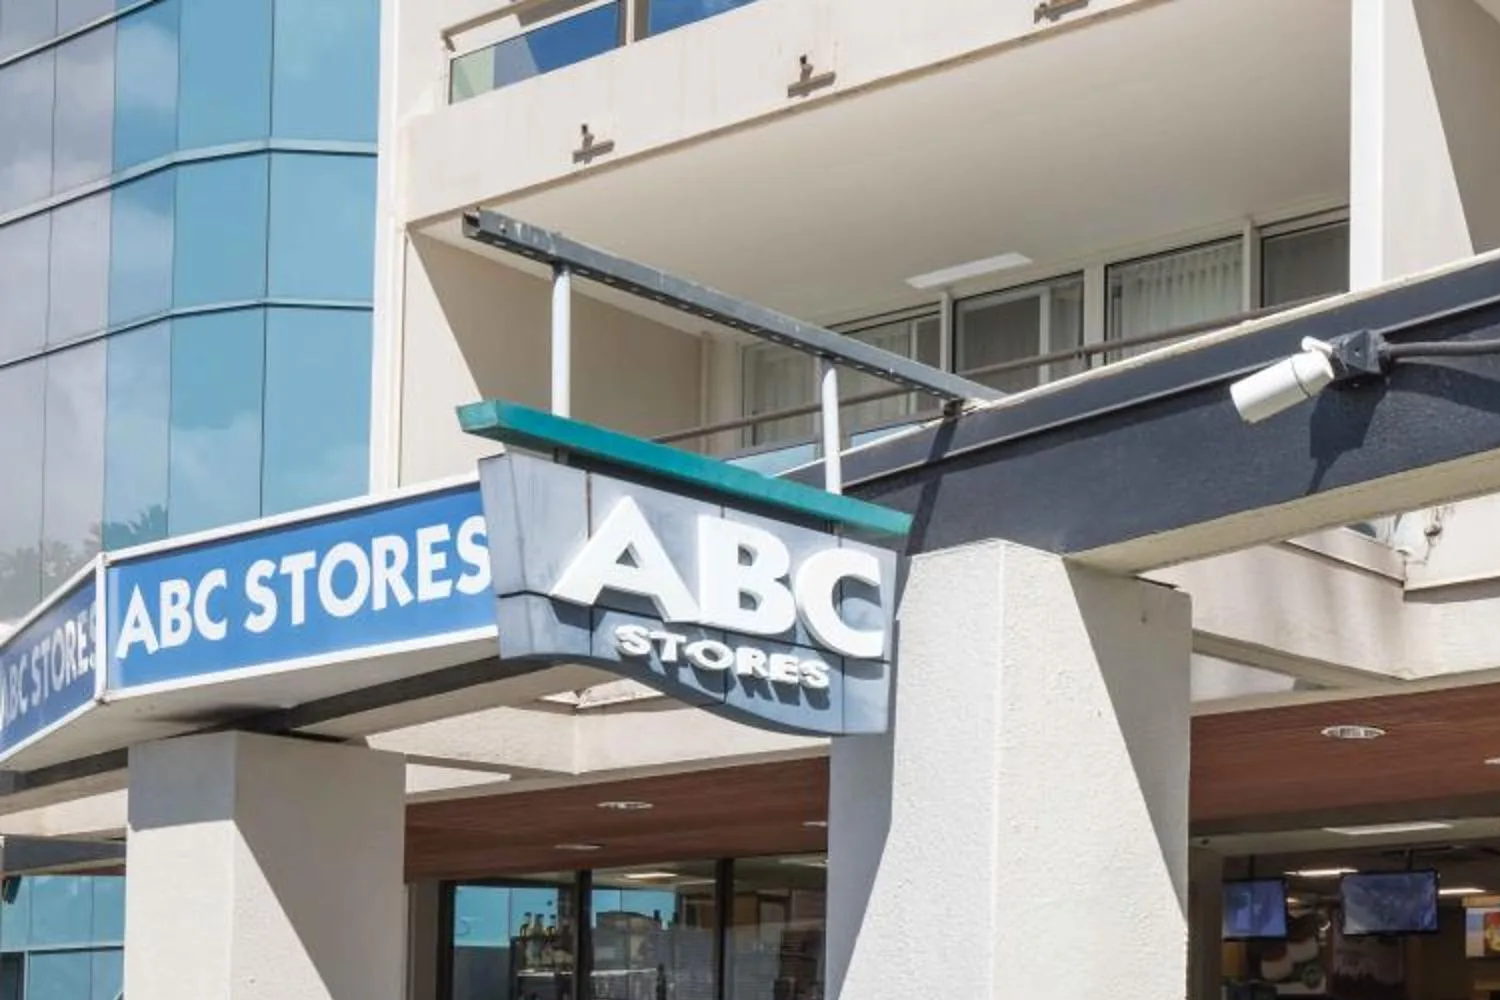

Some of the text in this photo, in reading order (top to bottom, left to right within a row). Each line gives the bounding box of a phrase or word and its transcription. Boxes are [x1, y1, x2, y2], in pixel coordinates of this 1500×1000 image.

[116, 515, 493, 660] ABC STORES
[550, 496, 886, 658] ABC
[31, 601, 96, 707] STORES
[614, 623, 831, 690] STORES
